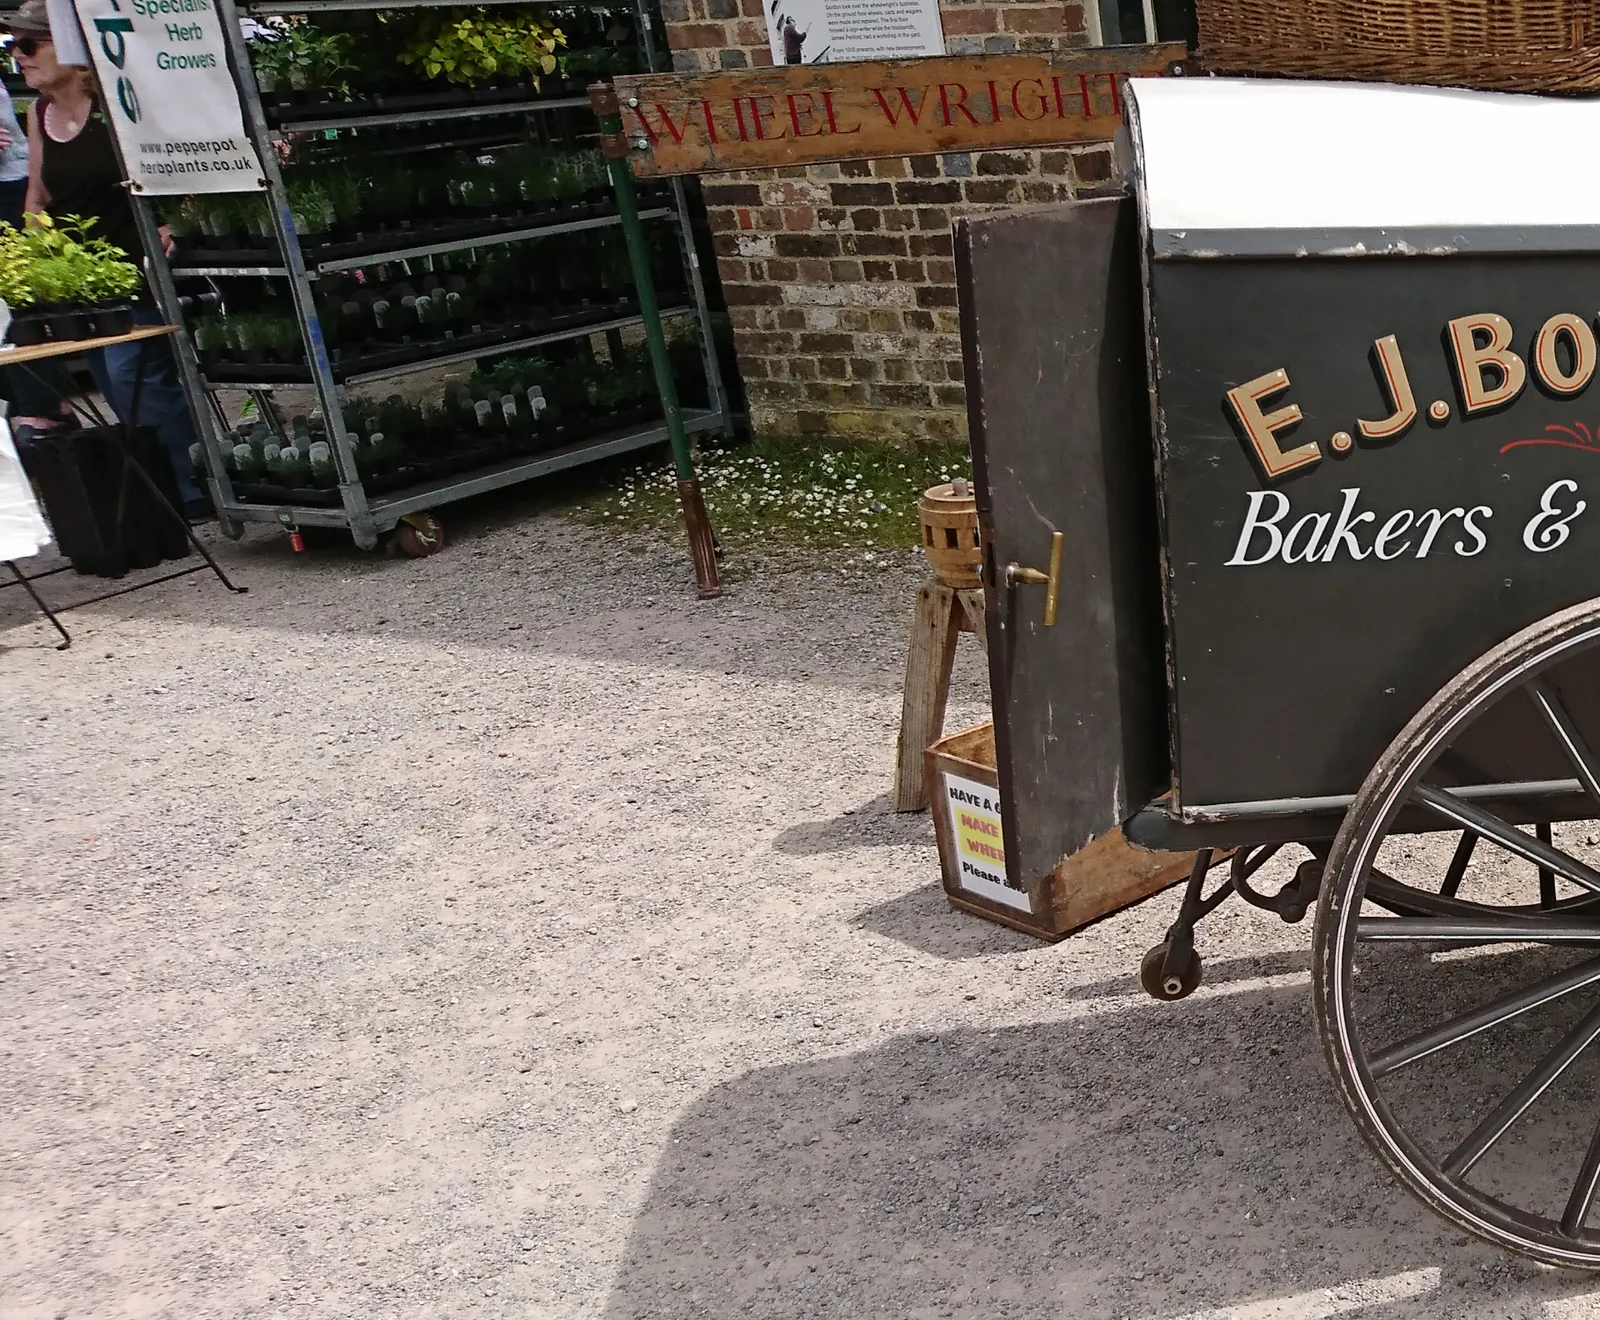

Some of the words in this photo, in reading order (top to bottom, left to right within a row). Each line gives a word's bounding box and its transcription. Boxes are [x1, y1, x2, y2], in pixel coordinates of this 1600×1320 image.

[165, 22, 203, 42] Herb
[156, 52, 217, 70] Growers
[635, 91, 861, 145] WHEEL
[140, 138, 238, 156] www.pepperpot
[139, 156, 253, 176] herbplants.co.uk
[1223, 488, 1493, 567] Bakers
[1522, 478, 1587, 553] &
[949, 787, 981, 808] HAVE
[984, 798, 993, 812] A
[961, 813, 999, 837] MAKE
[962, 861, 1001, 885] Please
